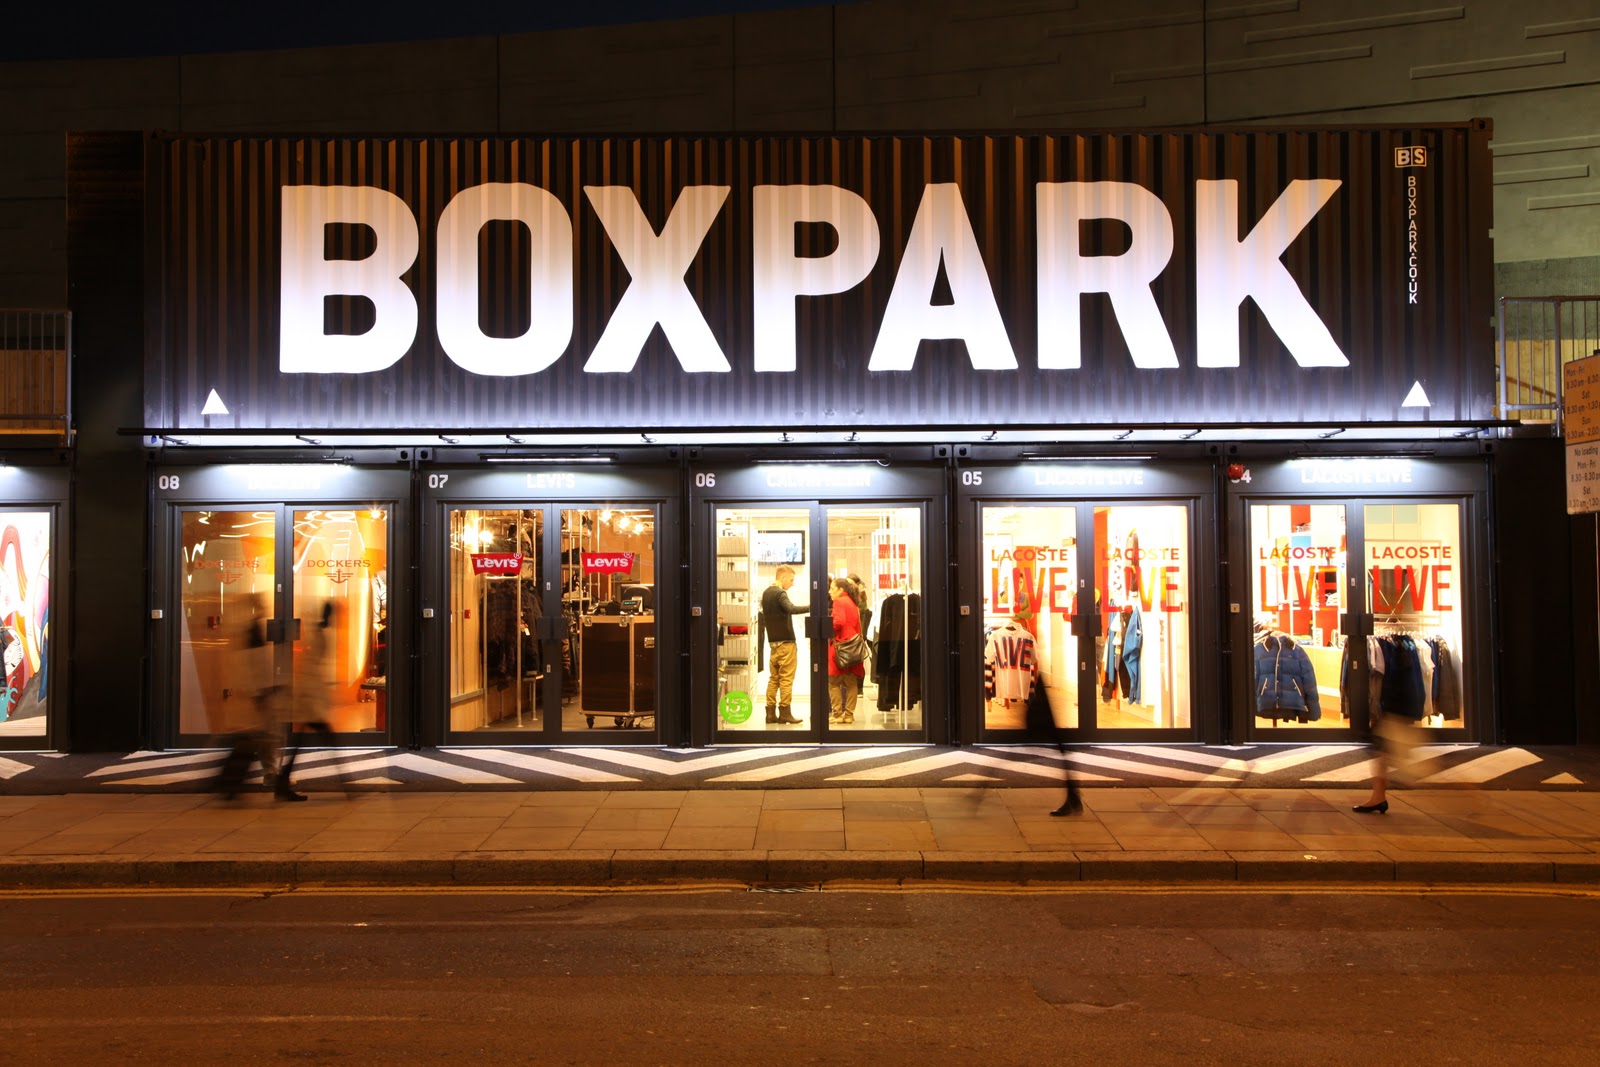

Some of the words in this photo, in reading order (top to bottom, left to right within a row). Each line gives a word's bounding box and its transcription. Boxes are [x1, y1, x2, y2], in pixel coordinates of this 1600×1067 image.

[279, 179, 1350, 376] BOXPARK
[159, 475, 180, 490] 08
[428, 474, 448, 489] 07
[527, 473, 576, 489] LEVI'S
[695, 473, 716, 488] 06
[962, 471, 982, 486] 05
[991, 549, 1068, 562] LACOSTE
[1102, 548, 1179, 561] LACOSTE
[1260, 547, 1337, 560] LACOSTE
[1372, 546, 1452, 559] LACOSTE
[195, 559, 260, 569] DOCKERS
[307, 559, 371, 568] DOCKERS
